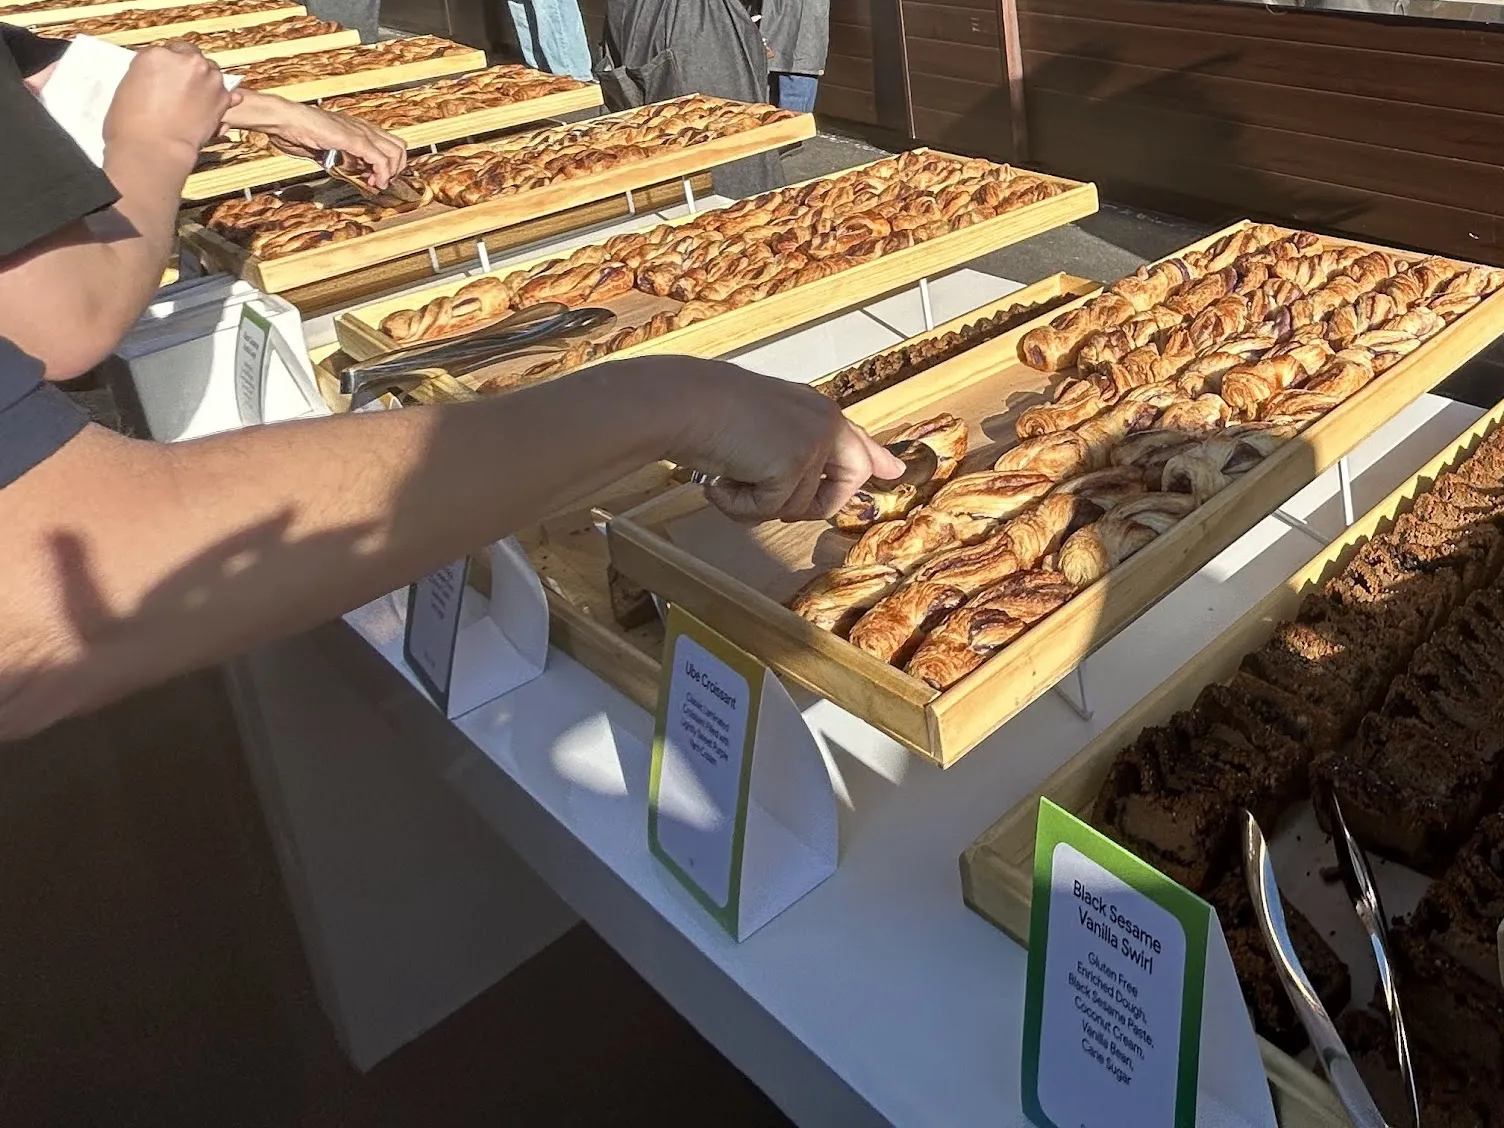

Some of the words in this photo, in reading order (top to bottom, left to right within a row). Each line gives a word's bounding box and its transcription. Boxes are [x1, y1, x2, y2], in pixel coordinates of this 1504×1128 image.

[685, 660, 701, 683] Ube
[1073, 879, 1107, 917] Black
[1109, 905, 1162, 954] Sesame
[1078, 906, 1118, 949] Vanilla
[1121, 938, 1153, 975] Swirl
[1068, 972, 1091, 999] Black
[1091, 990, 1126, 1025] Sesame
[1077, 961, 1114, 998] Enriched
[1088, 952, 1117, 982] Gluten
[1118, 973, 1138, 998] Free
[1074, 995, 1112, 1033] Coconut
[1081, 1038, 1105, 1064] Cane
[1106, 1056, 1132, 1086] Sugar
